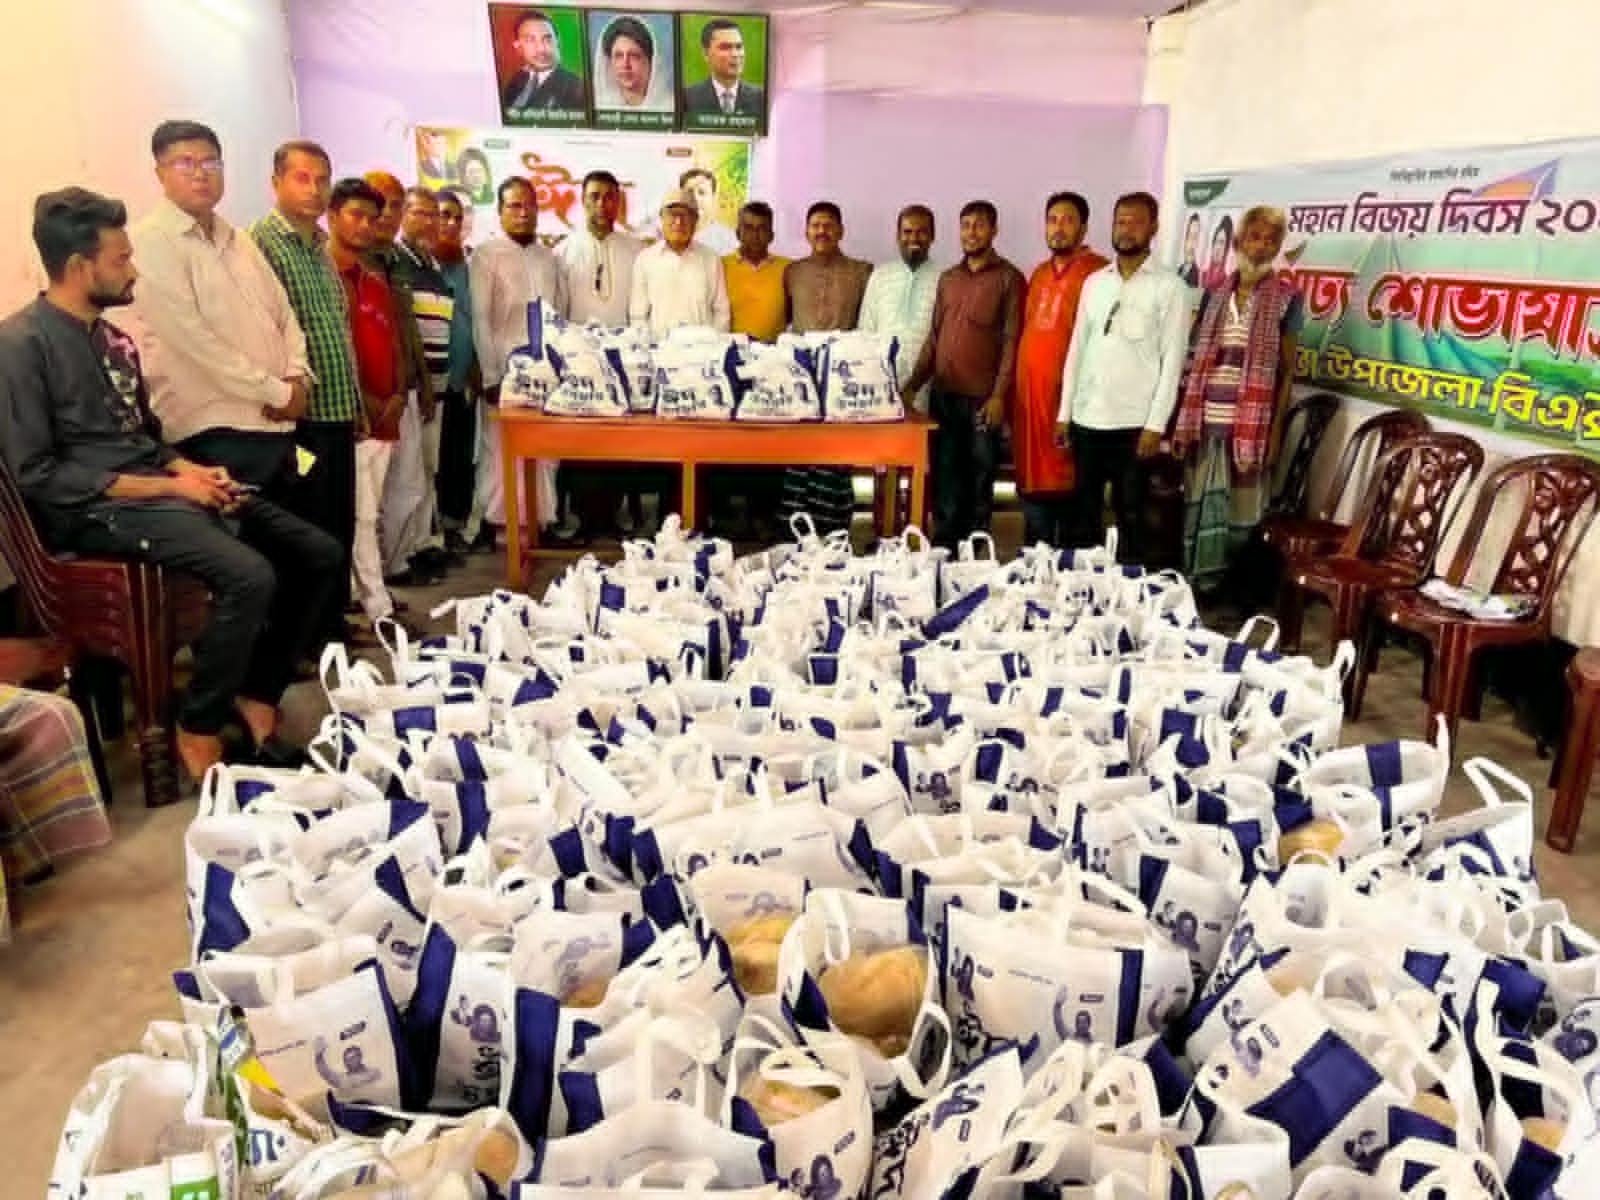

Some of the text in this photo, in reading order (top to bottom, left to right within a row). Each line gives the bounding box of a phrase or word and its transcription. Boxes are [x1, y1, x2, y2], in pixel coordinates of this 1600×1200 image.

[1287, 187, 1600, 239] মহান বিজয় দিবস ২০
[1326, 344, 1484, 409] উপজেলা
